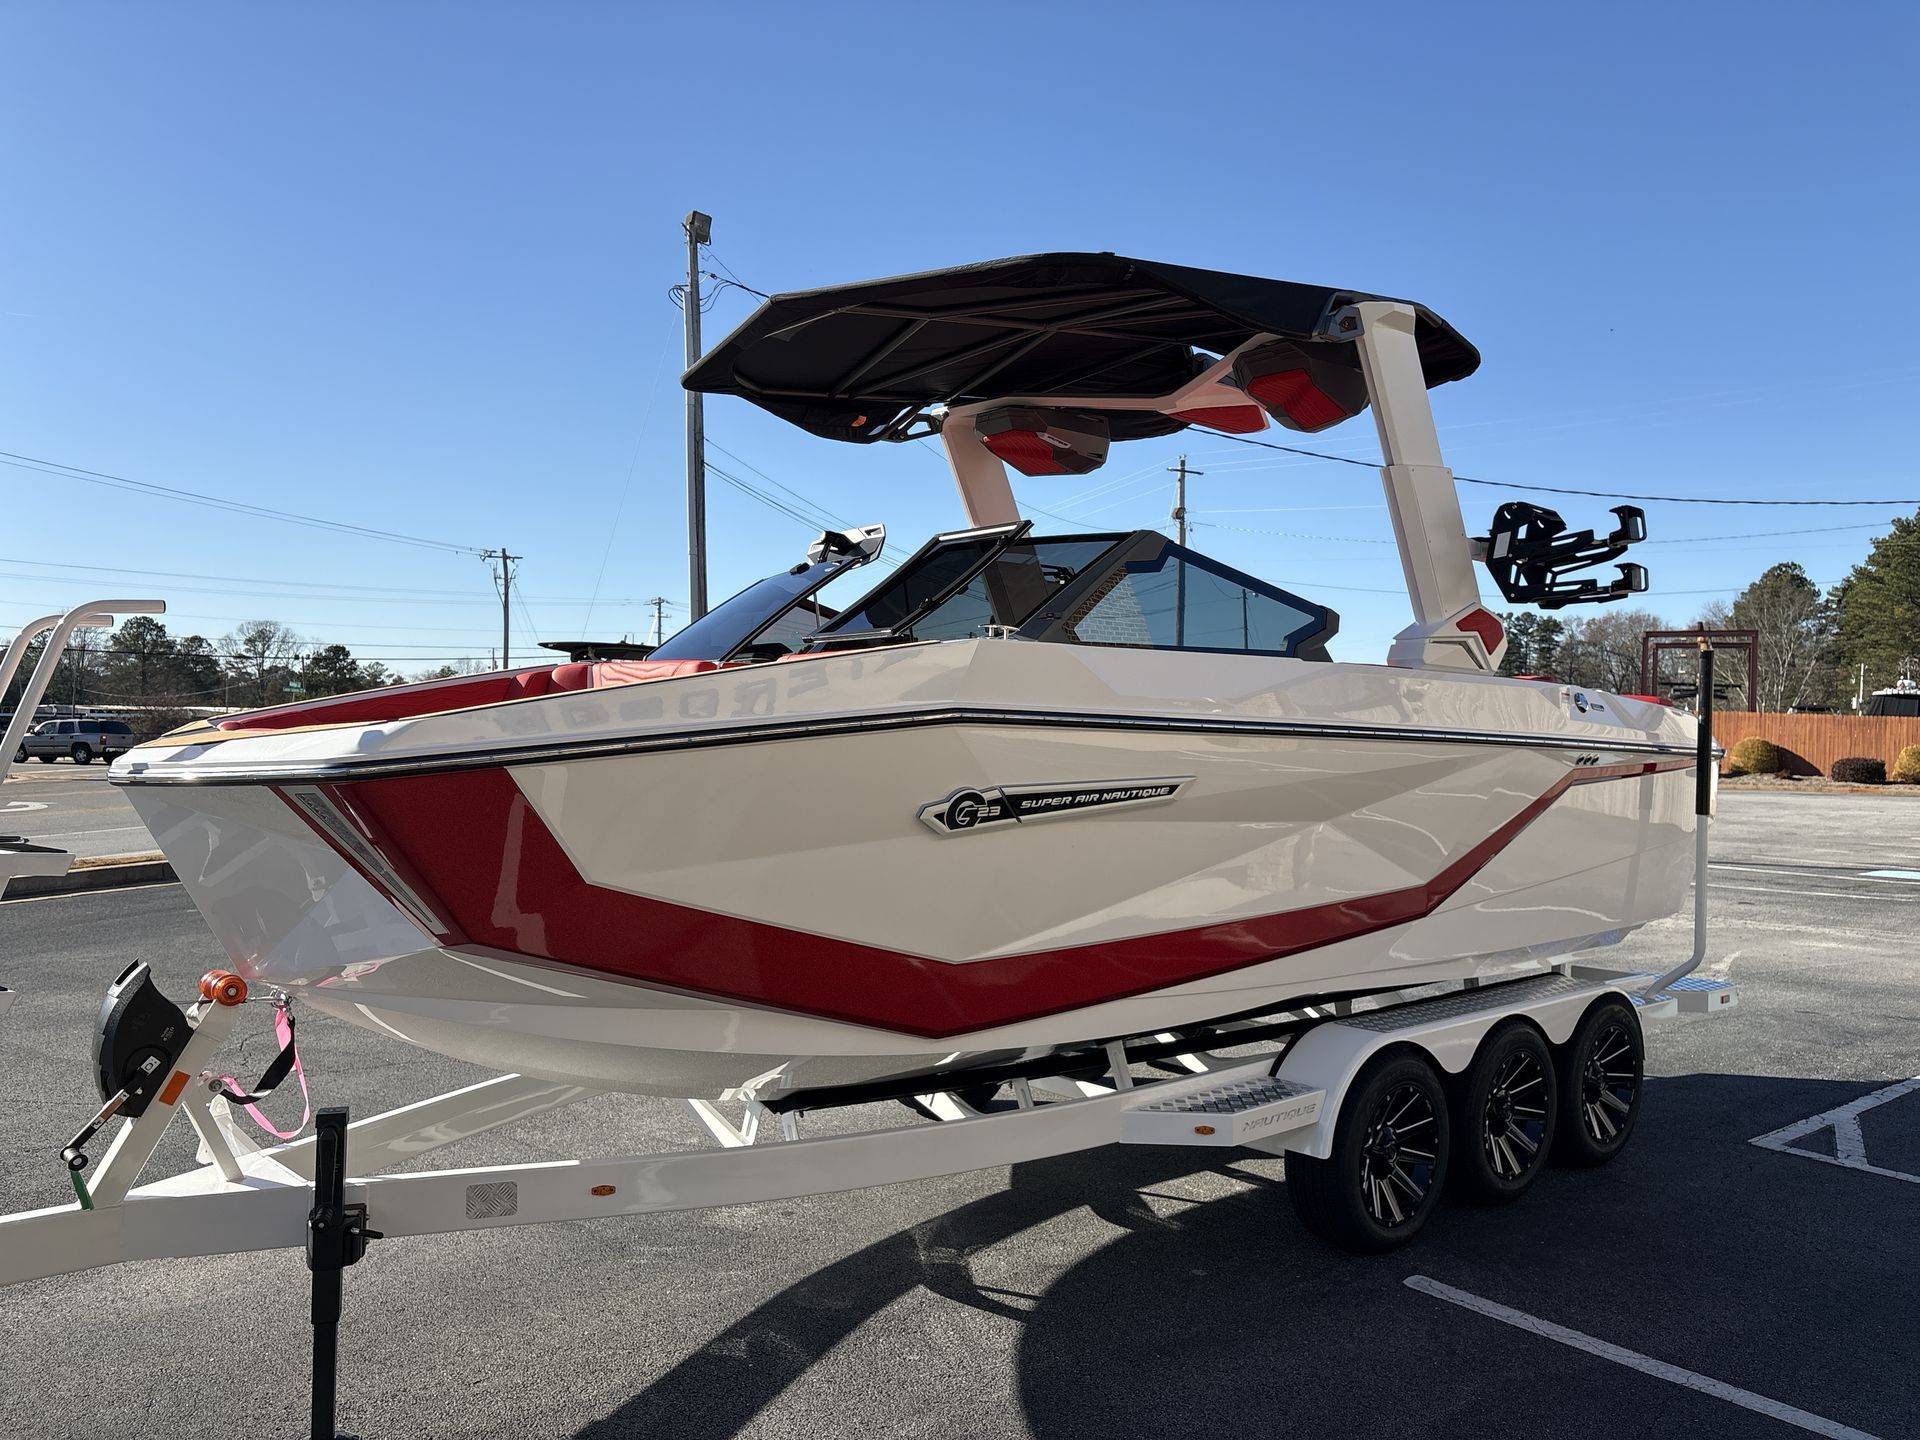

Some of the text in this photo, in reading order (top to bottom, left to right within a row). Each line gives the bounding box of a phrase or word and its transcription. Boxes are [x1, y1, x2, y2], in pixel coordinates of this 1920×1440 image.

[1020, 786, 1170, 809] SUPER AIR NAUTIQUE
[1242, 1103, 1317, 1132] NAUTIQUE
